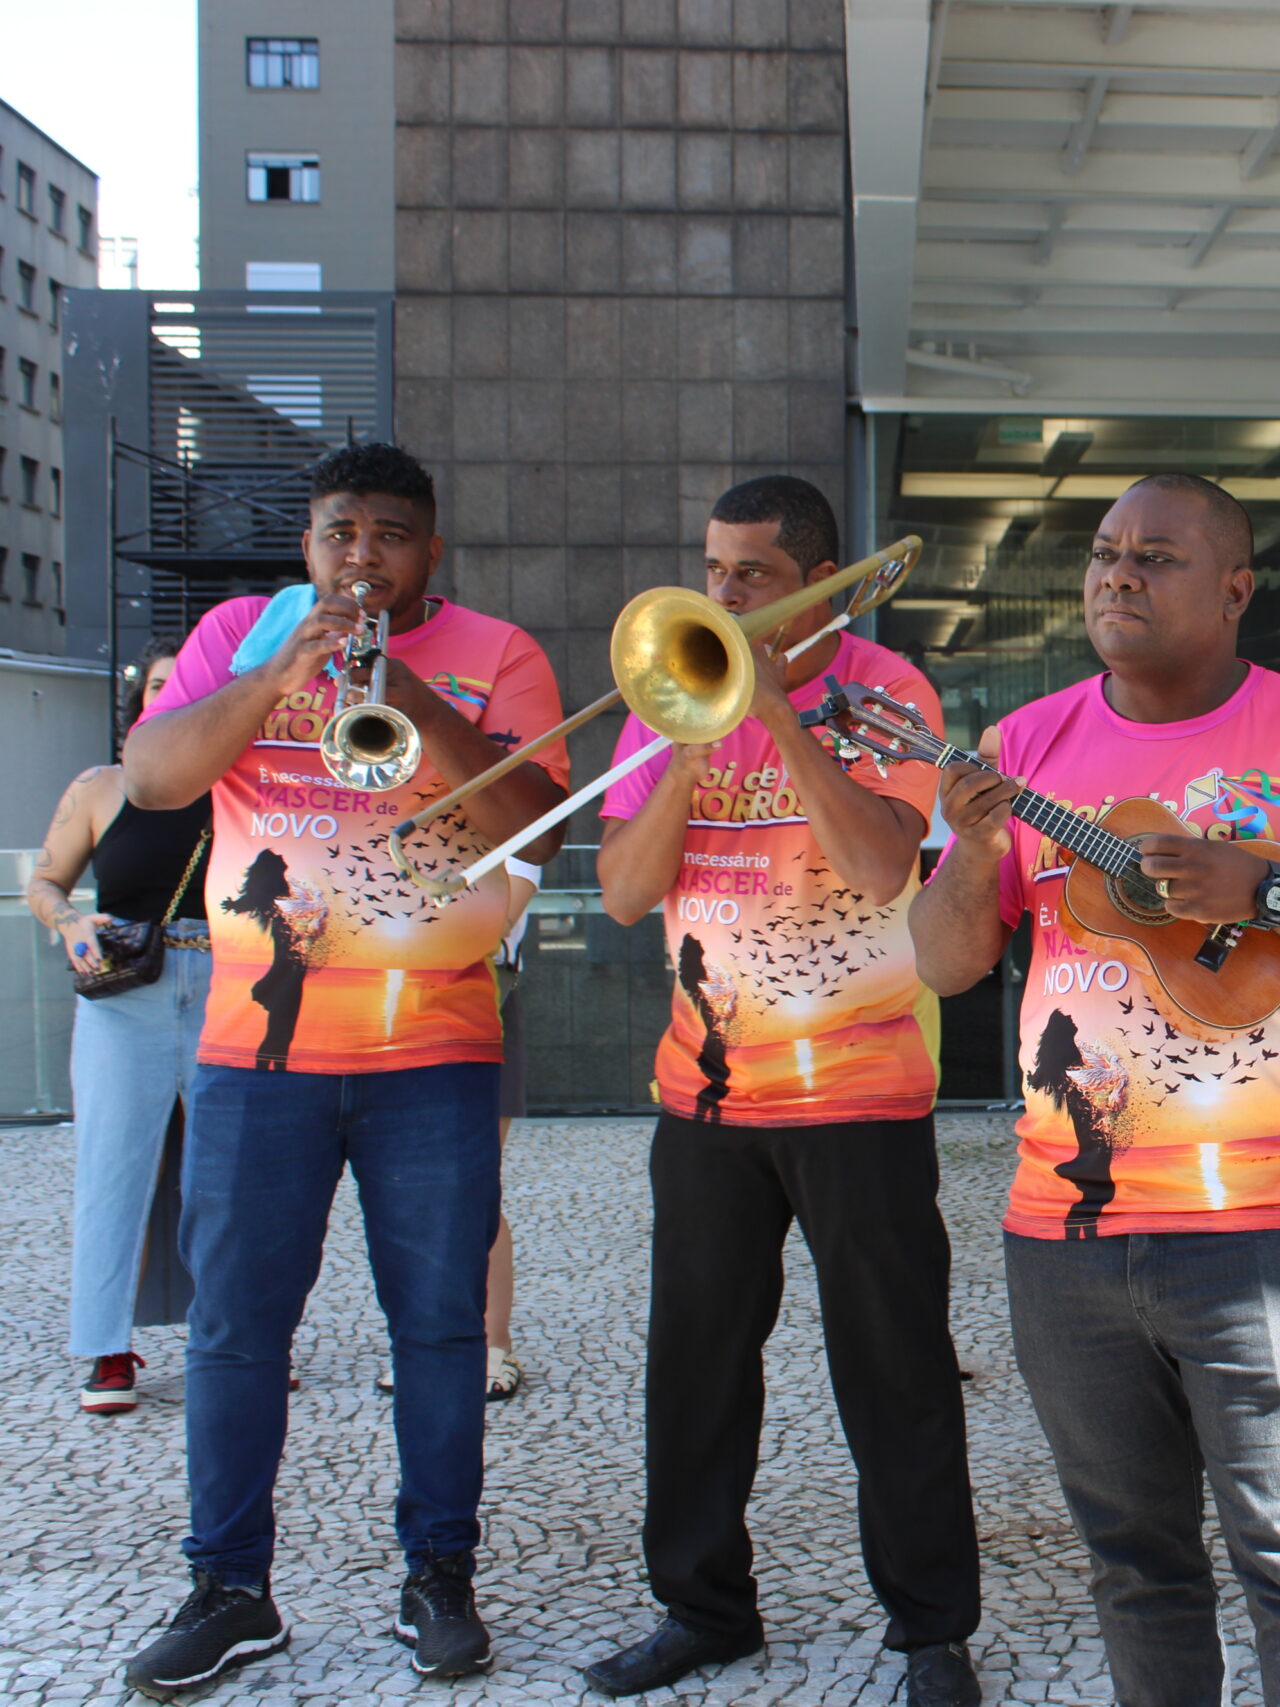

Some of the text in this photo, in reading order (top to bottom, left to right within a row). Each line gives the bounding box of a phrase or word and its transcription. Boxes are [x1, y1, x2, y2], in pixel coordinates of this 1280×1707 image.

[256, 786, 399, 816] NASCER de
[250, 812, 339, 840] NOVO
[773, 882, 793, 897] de
[1043, 960, 1129, 996] NOVO
